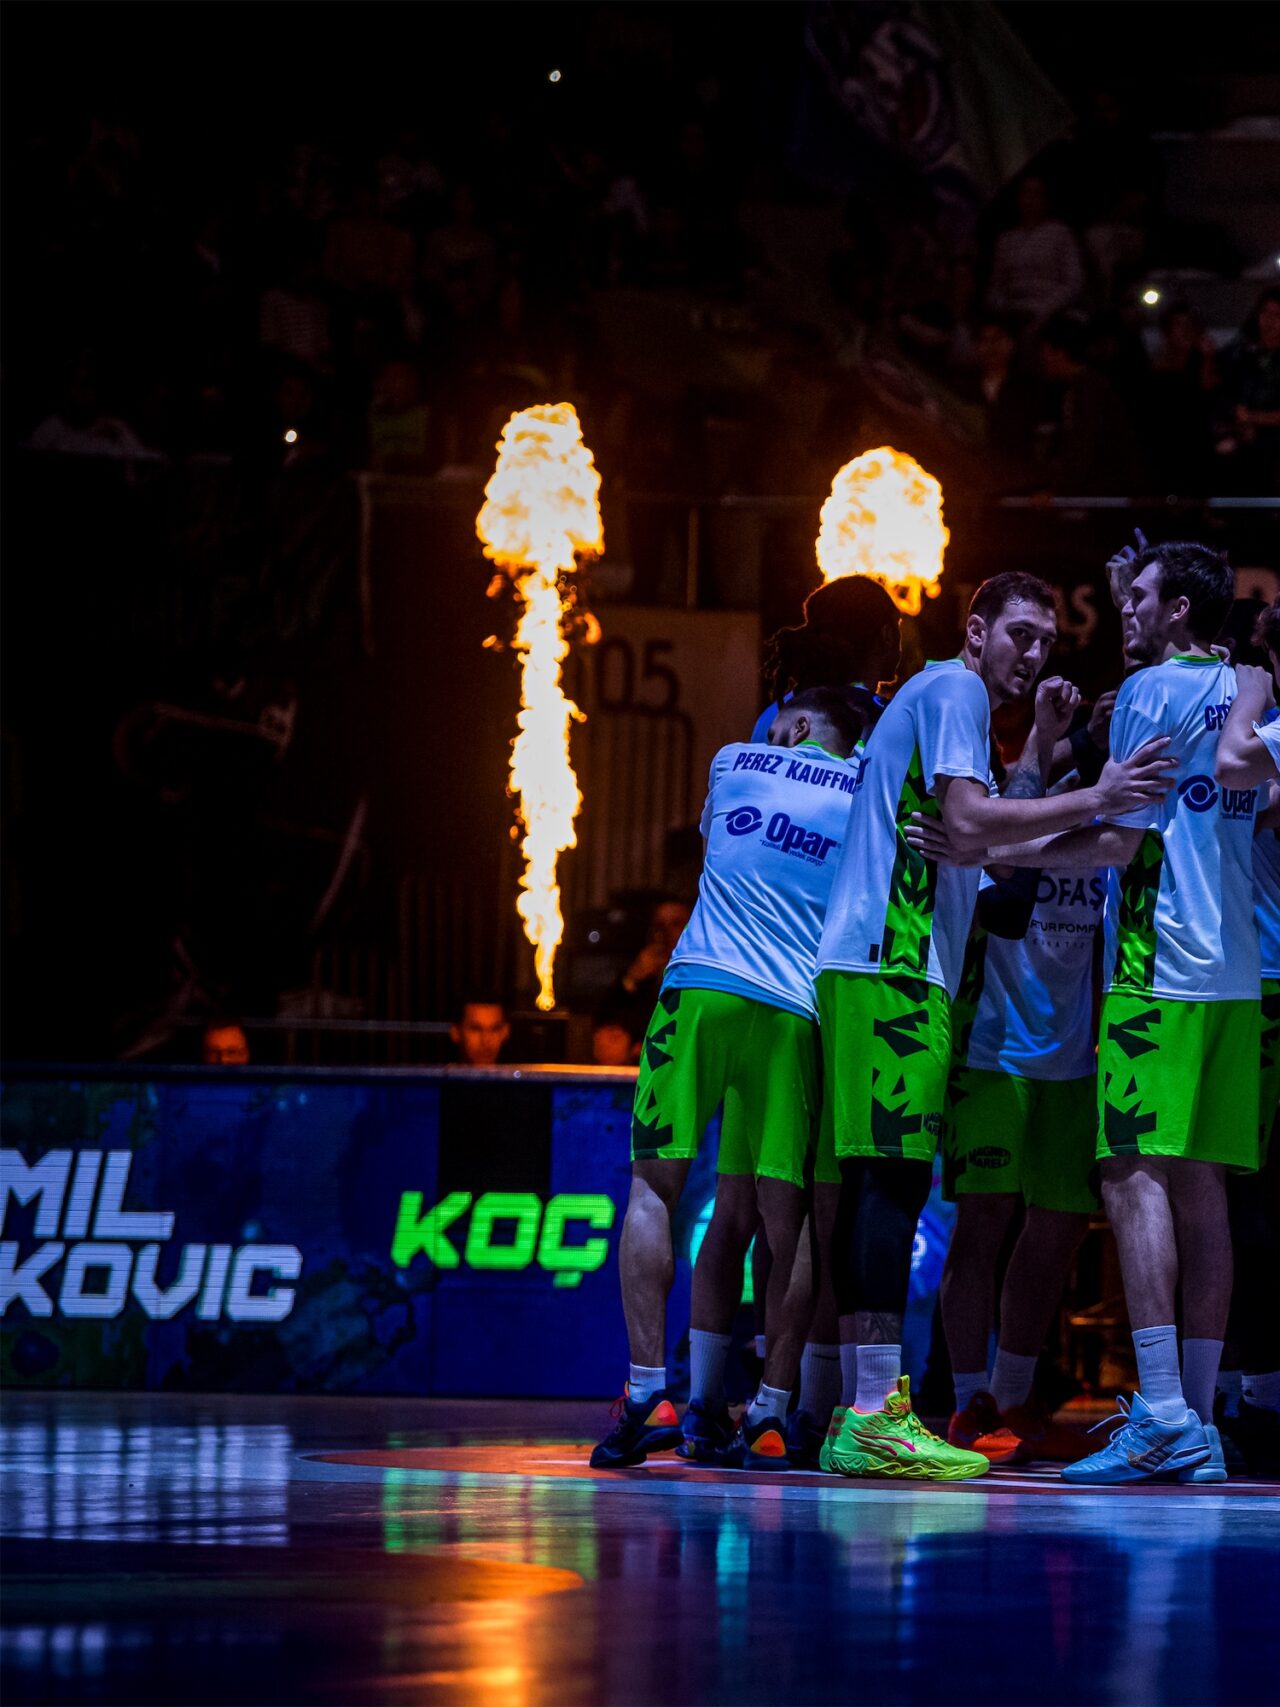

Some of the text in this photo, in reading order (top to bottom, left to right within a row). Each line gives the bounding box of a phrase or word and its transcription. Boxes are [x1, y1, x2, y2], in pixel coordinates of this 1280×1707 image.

[732, 751, 784, 776] PEREZ
[765, 811, 837, 862] Opar
[1034, 875, 1106, 912] OFAŞ
[390, 1190, 617, 1289] KOÇ
